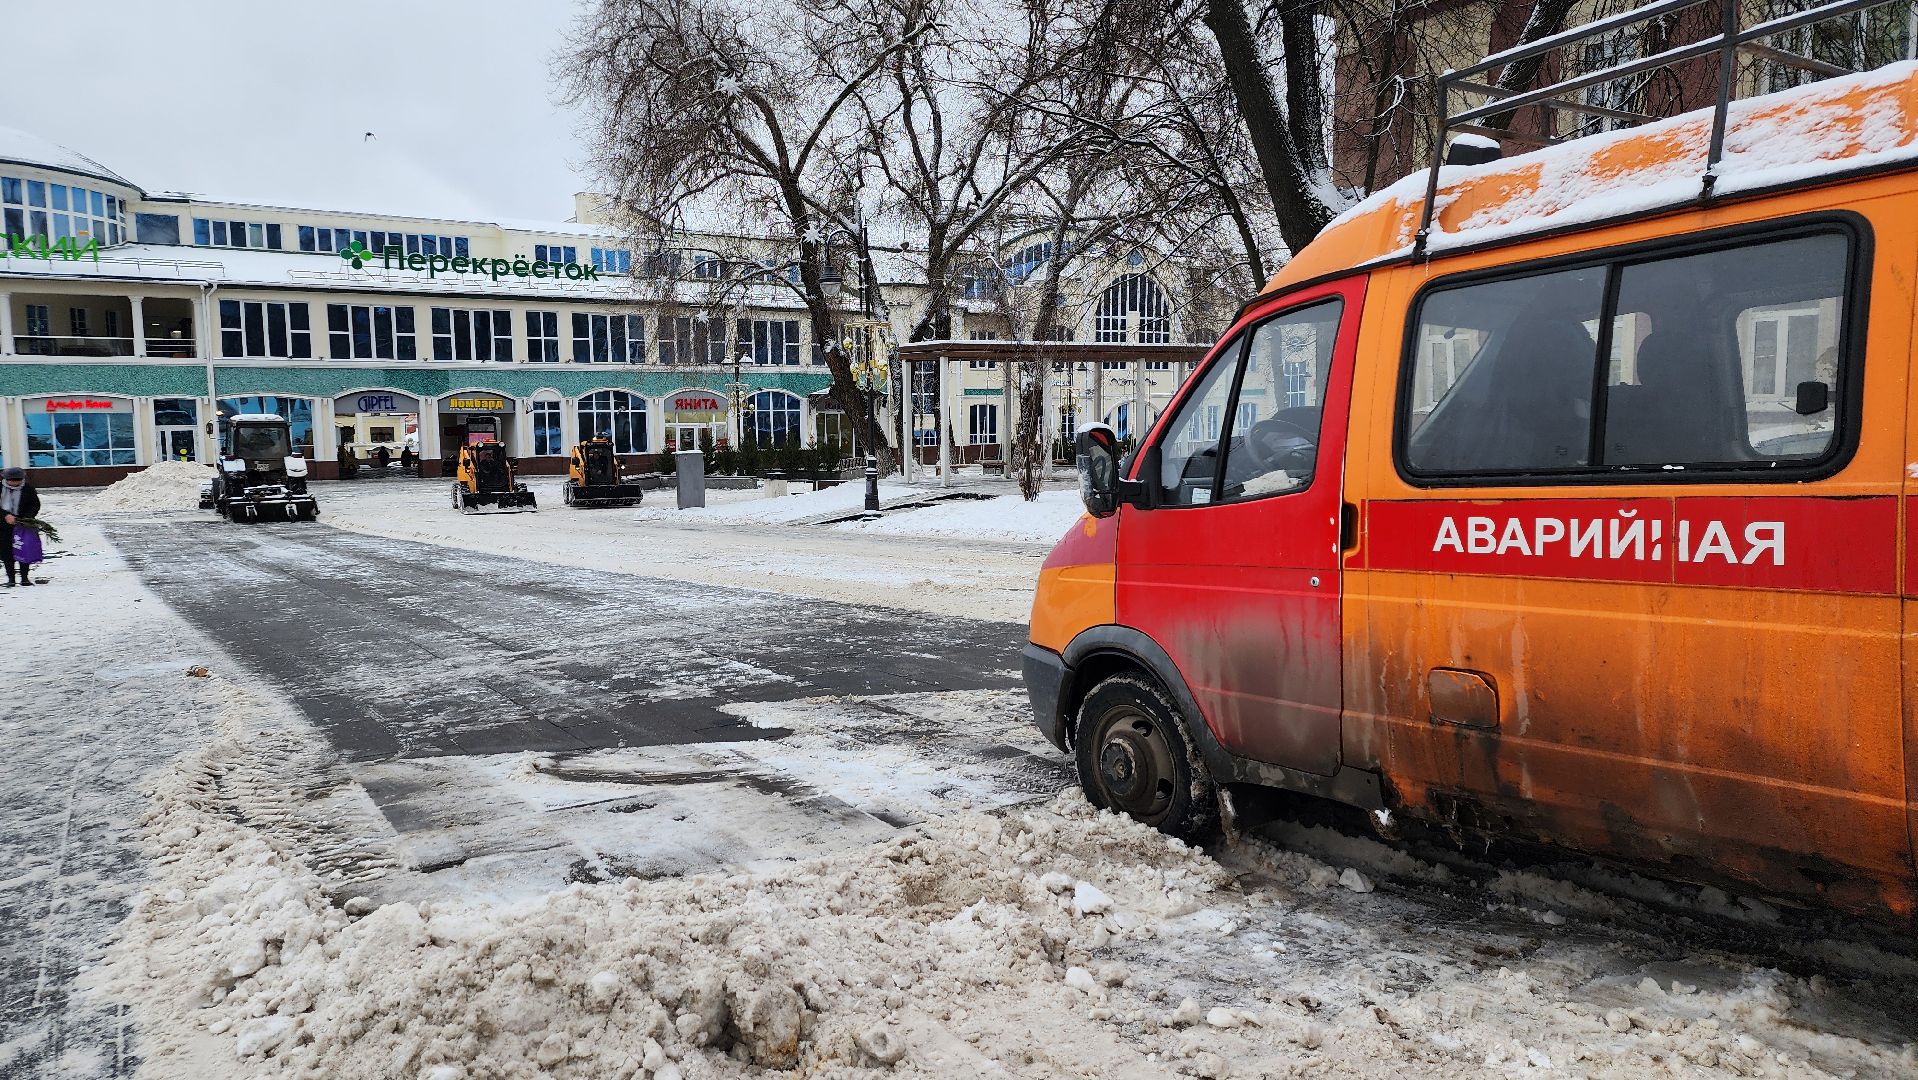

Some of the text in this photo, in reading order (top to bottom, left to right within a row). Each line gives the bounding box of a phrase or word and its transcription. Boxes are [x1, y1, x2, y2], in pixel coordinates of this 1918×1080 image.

[383, 244, 600, 282] Перекрёсток
[358, 395, 397, 412] GIPFEL
[449, 398, 504, 410] Ломбард
[674, 398, 719, 410] ЯНИТА
